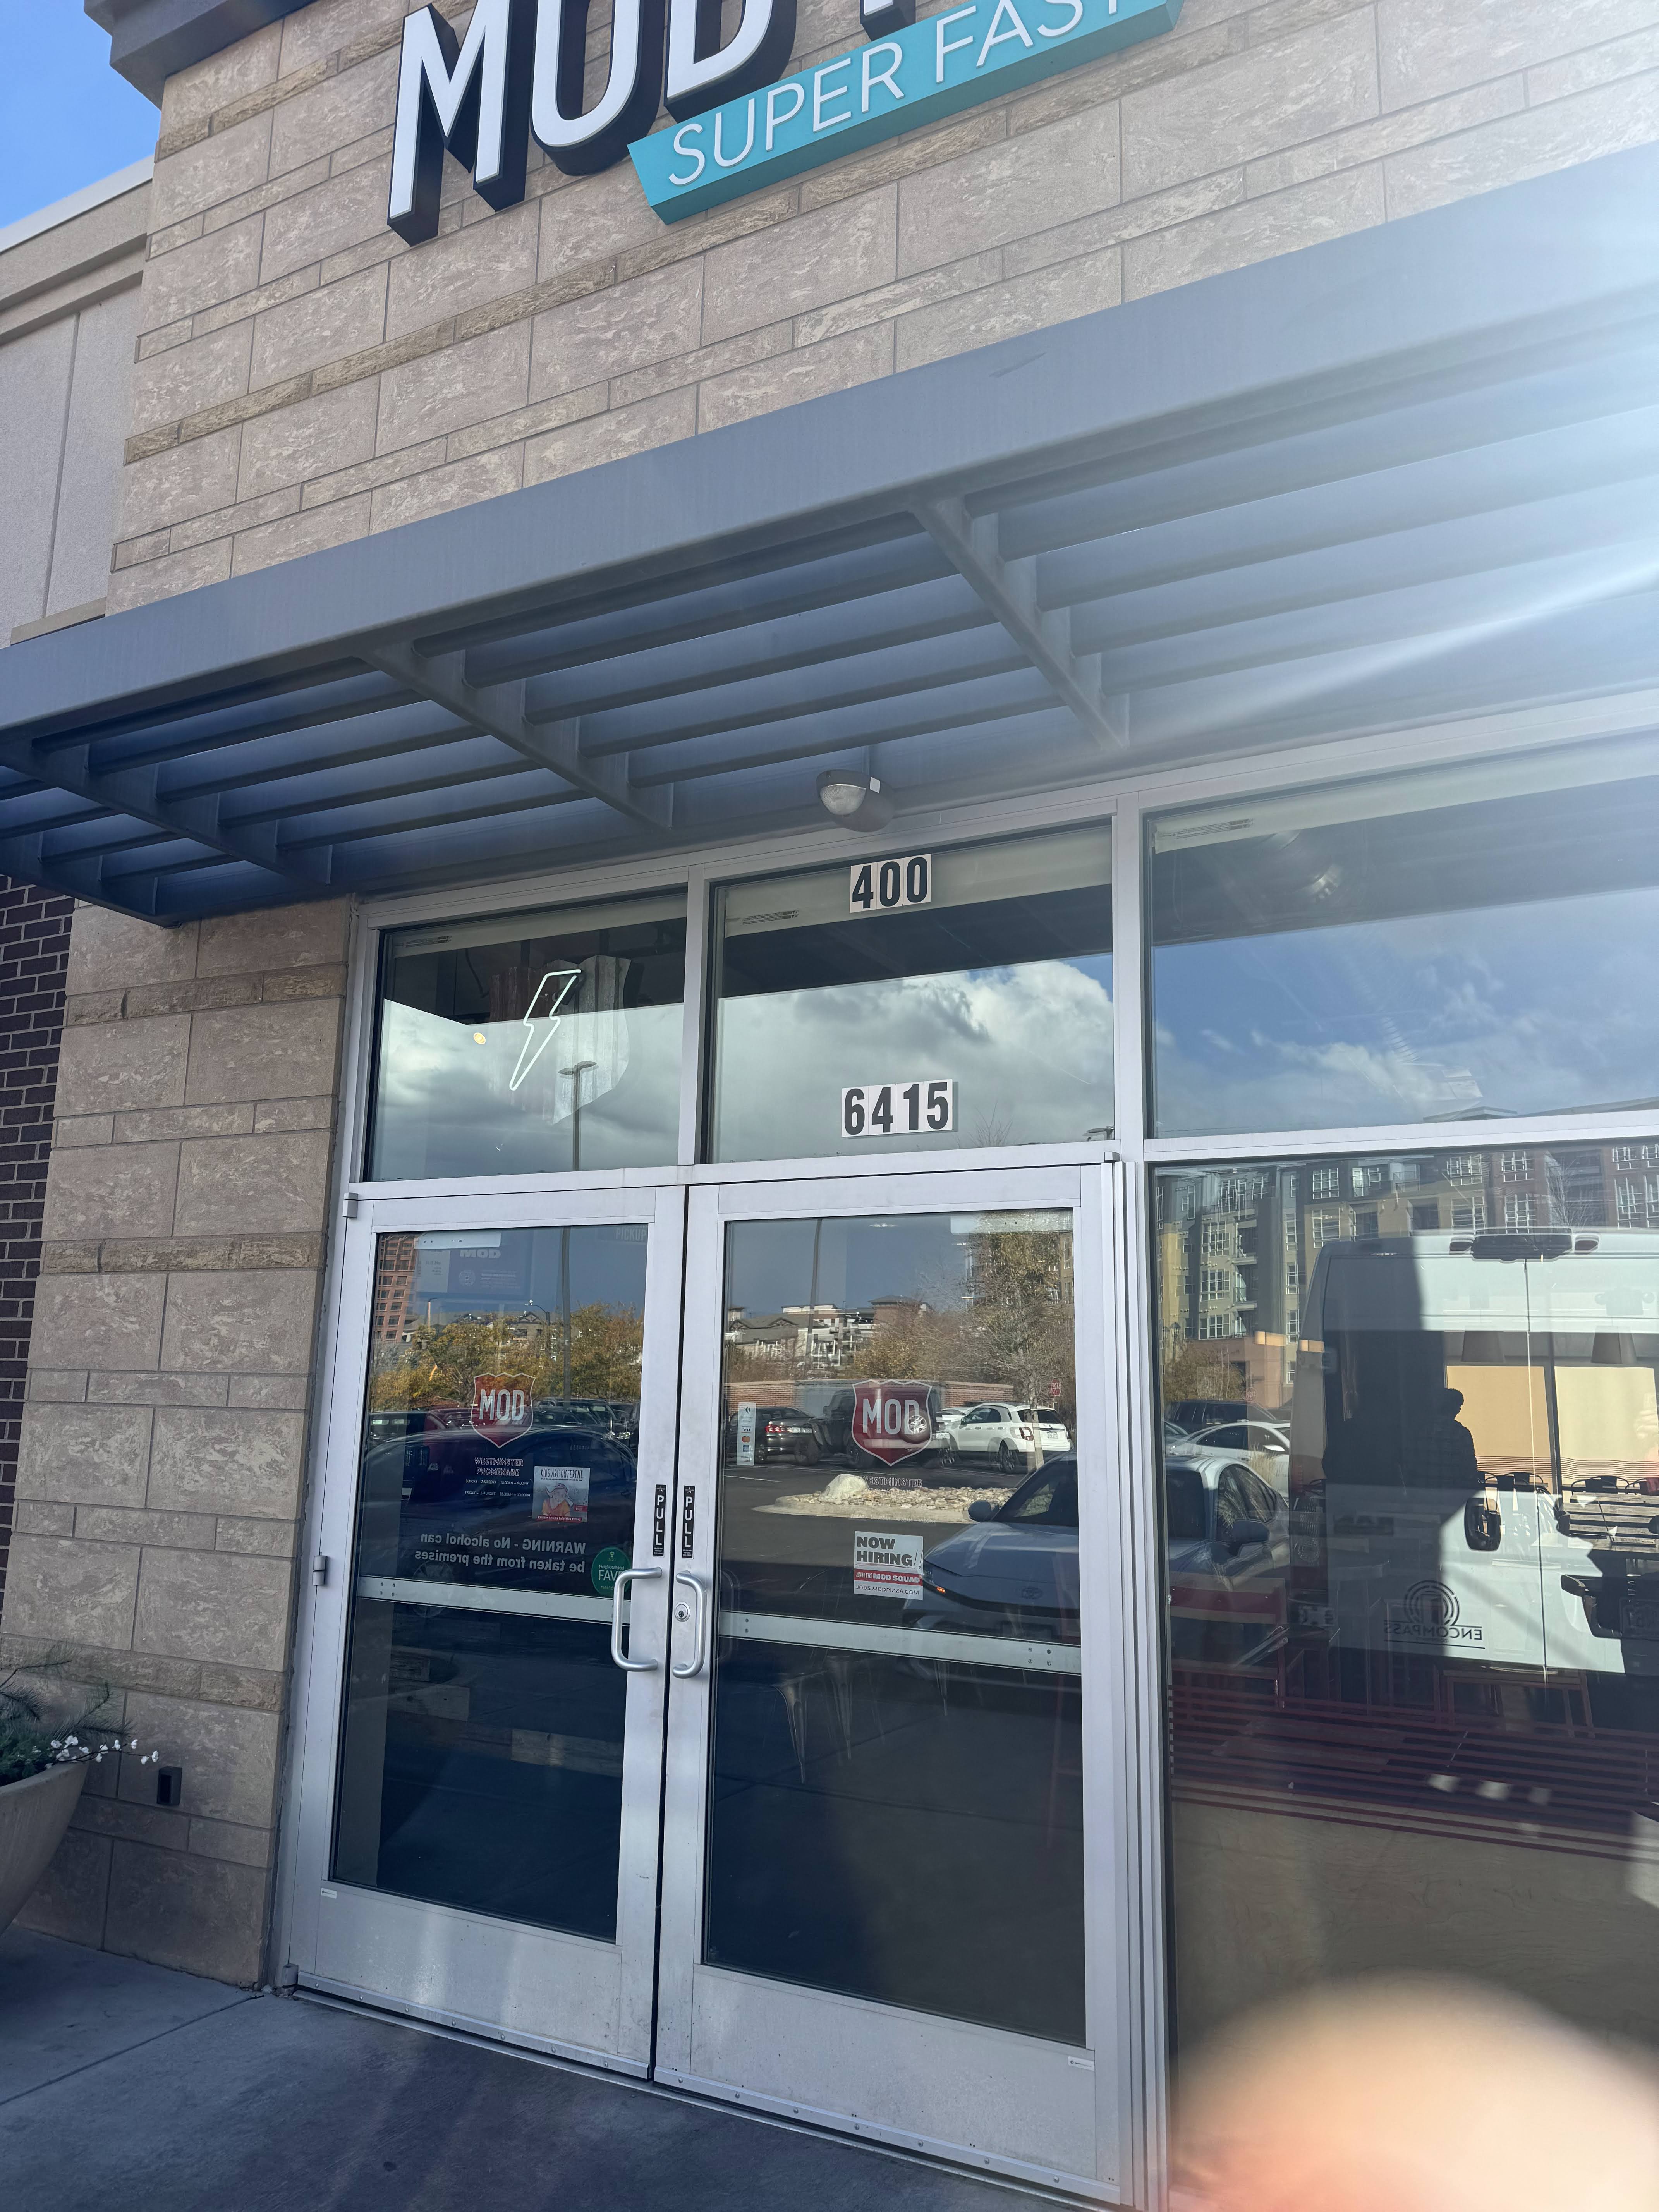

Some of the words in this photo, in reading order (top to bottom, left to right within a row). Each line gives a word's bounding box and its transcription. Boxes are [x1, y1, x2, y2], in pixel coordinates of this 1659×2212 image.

[668, 42, 905, 185] SUPER
[936, 0, 1118, 84] FAS
[852, 857, 929, 910] 400
[844, 1082, 949, 1136] 6415
[615, 1227, 646, 1241] PICKUP
[460, 1249, 501, 1259] MOD
[479, 1389, 524, 1421] MOD
[863, 1398, 920, 1435] MOD
[474, 1457, 524, 1467] WESTMINSTER
[476, 1467, 520, 1477] PROMENADE
[541, 1468, 550, 1477] KIDS
[551, 1468, 560, 1477] ARE
[656, 1495, 665, 1546] PULL
[684, 1496, 693, 1547] PULL
[857, 1536, 896, 1550] NOW
[598, 1570, 623, 1581] FAV
[893, 1575, 920, 1583] SQUAD
